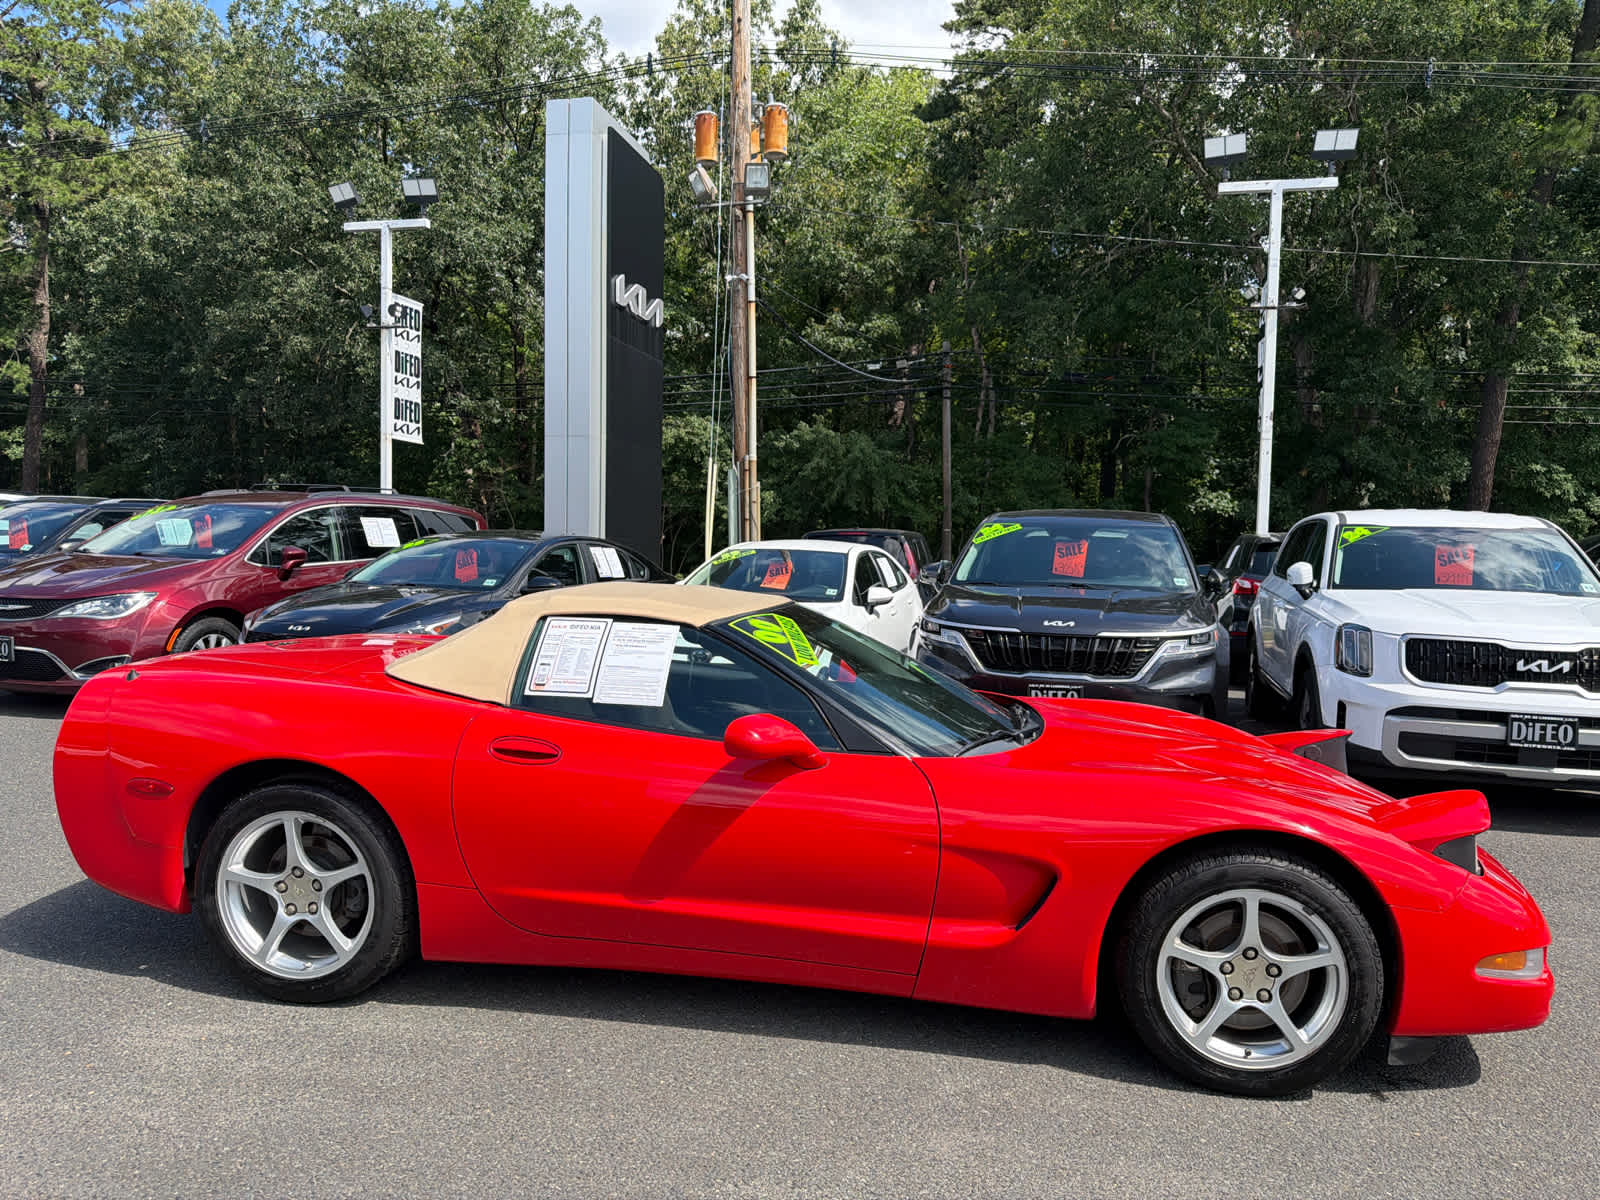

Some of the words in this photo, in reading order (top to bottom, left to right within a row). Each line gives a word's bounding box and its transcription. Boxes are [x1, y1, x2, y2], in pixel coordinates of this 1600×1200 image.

[615, 274, 664, 328] KIA
[394, 327, 420, 343] KIA
[394, 350, 420, 379] DiFEO
[394, 375, 420, 390] KIA
[394, 397, 420, 424] DiFEO
[394, 422, 420, 436] KIA
[1057, 543, 1085, 559] SALE
[1438, 549, 1471, 567] SALE
[1516, 658, 1570, 674] KIA
[1511, 721, 1574, 744] DiFEO
